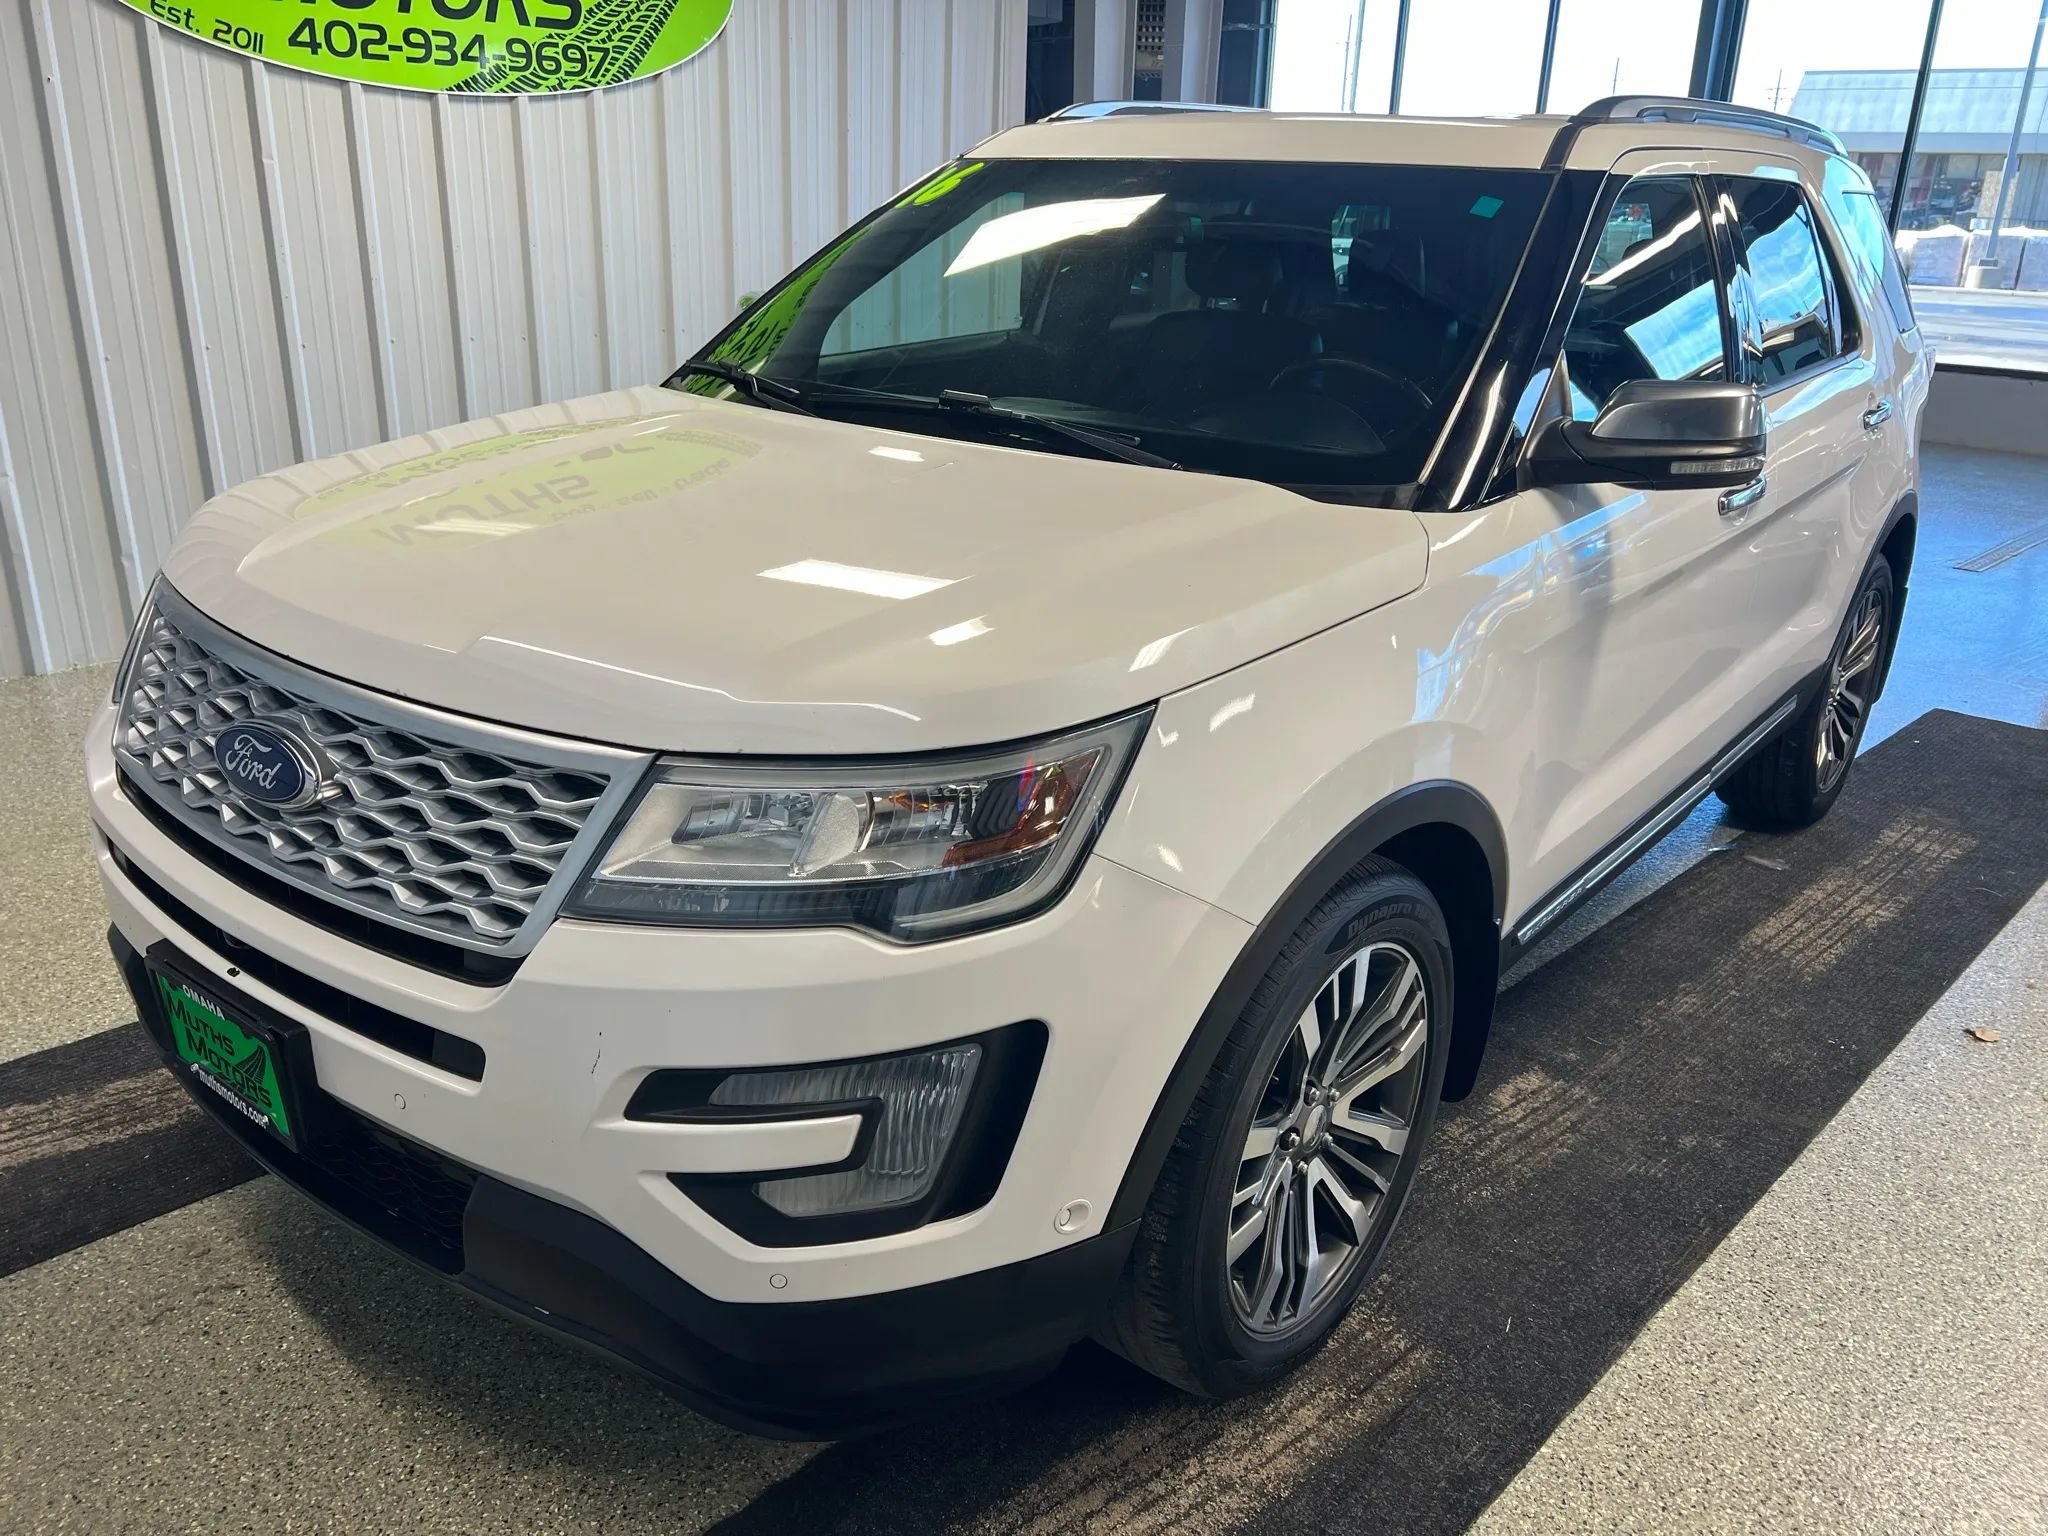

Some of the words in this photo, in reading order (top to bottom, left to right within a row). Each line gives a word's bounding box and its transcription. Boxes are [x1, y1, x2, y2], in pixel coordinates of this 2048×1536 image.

[150, 0, 200, 33] Est.
[213, 18, 264, 54] 2011
[287, 17, 611, 79] 402-934-9697
[224, 734, 282, 790] Ford
[167, 990, 235, 1057] MUTHS
[182, 984, 225, 1021] OMAHA
[185, 1027, 273, 1109] MOTORS
